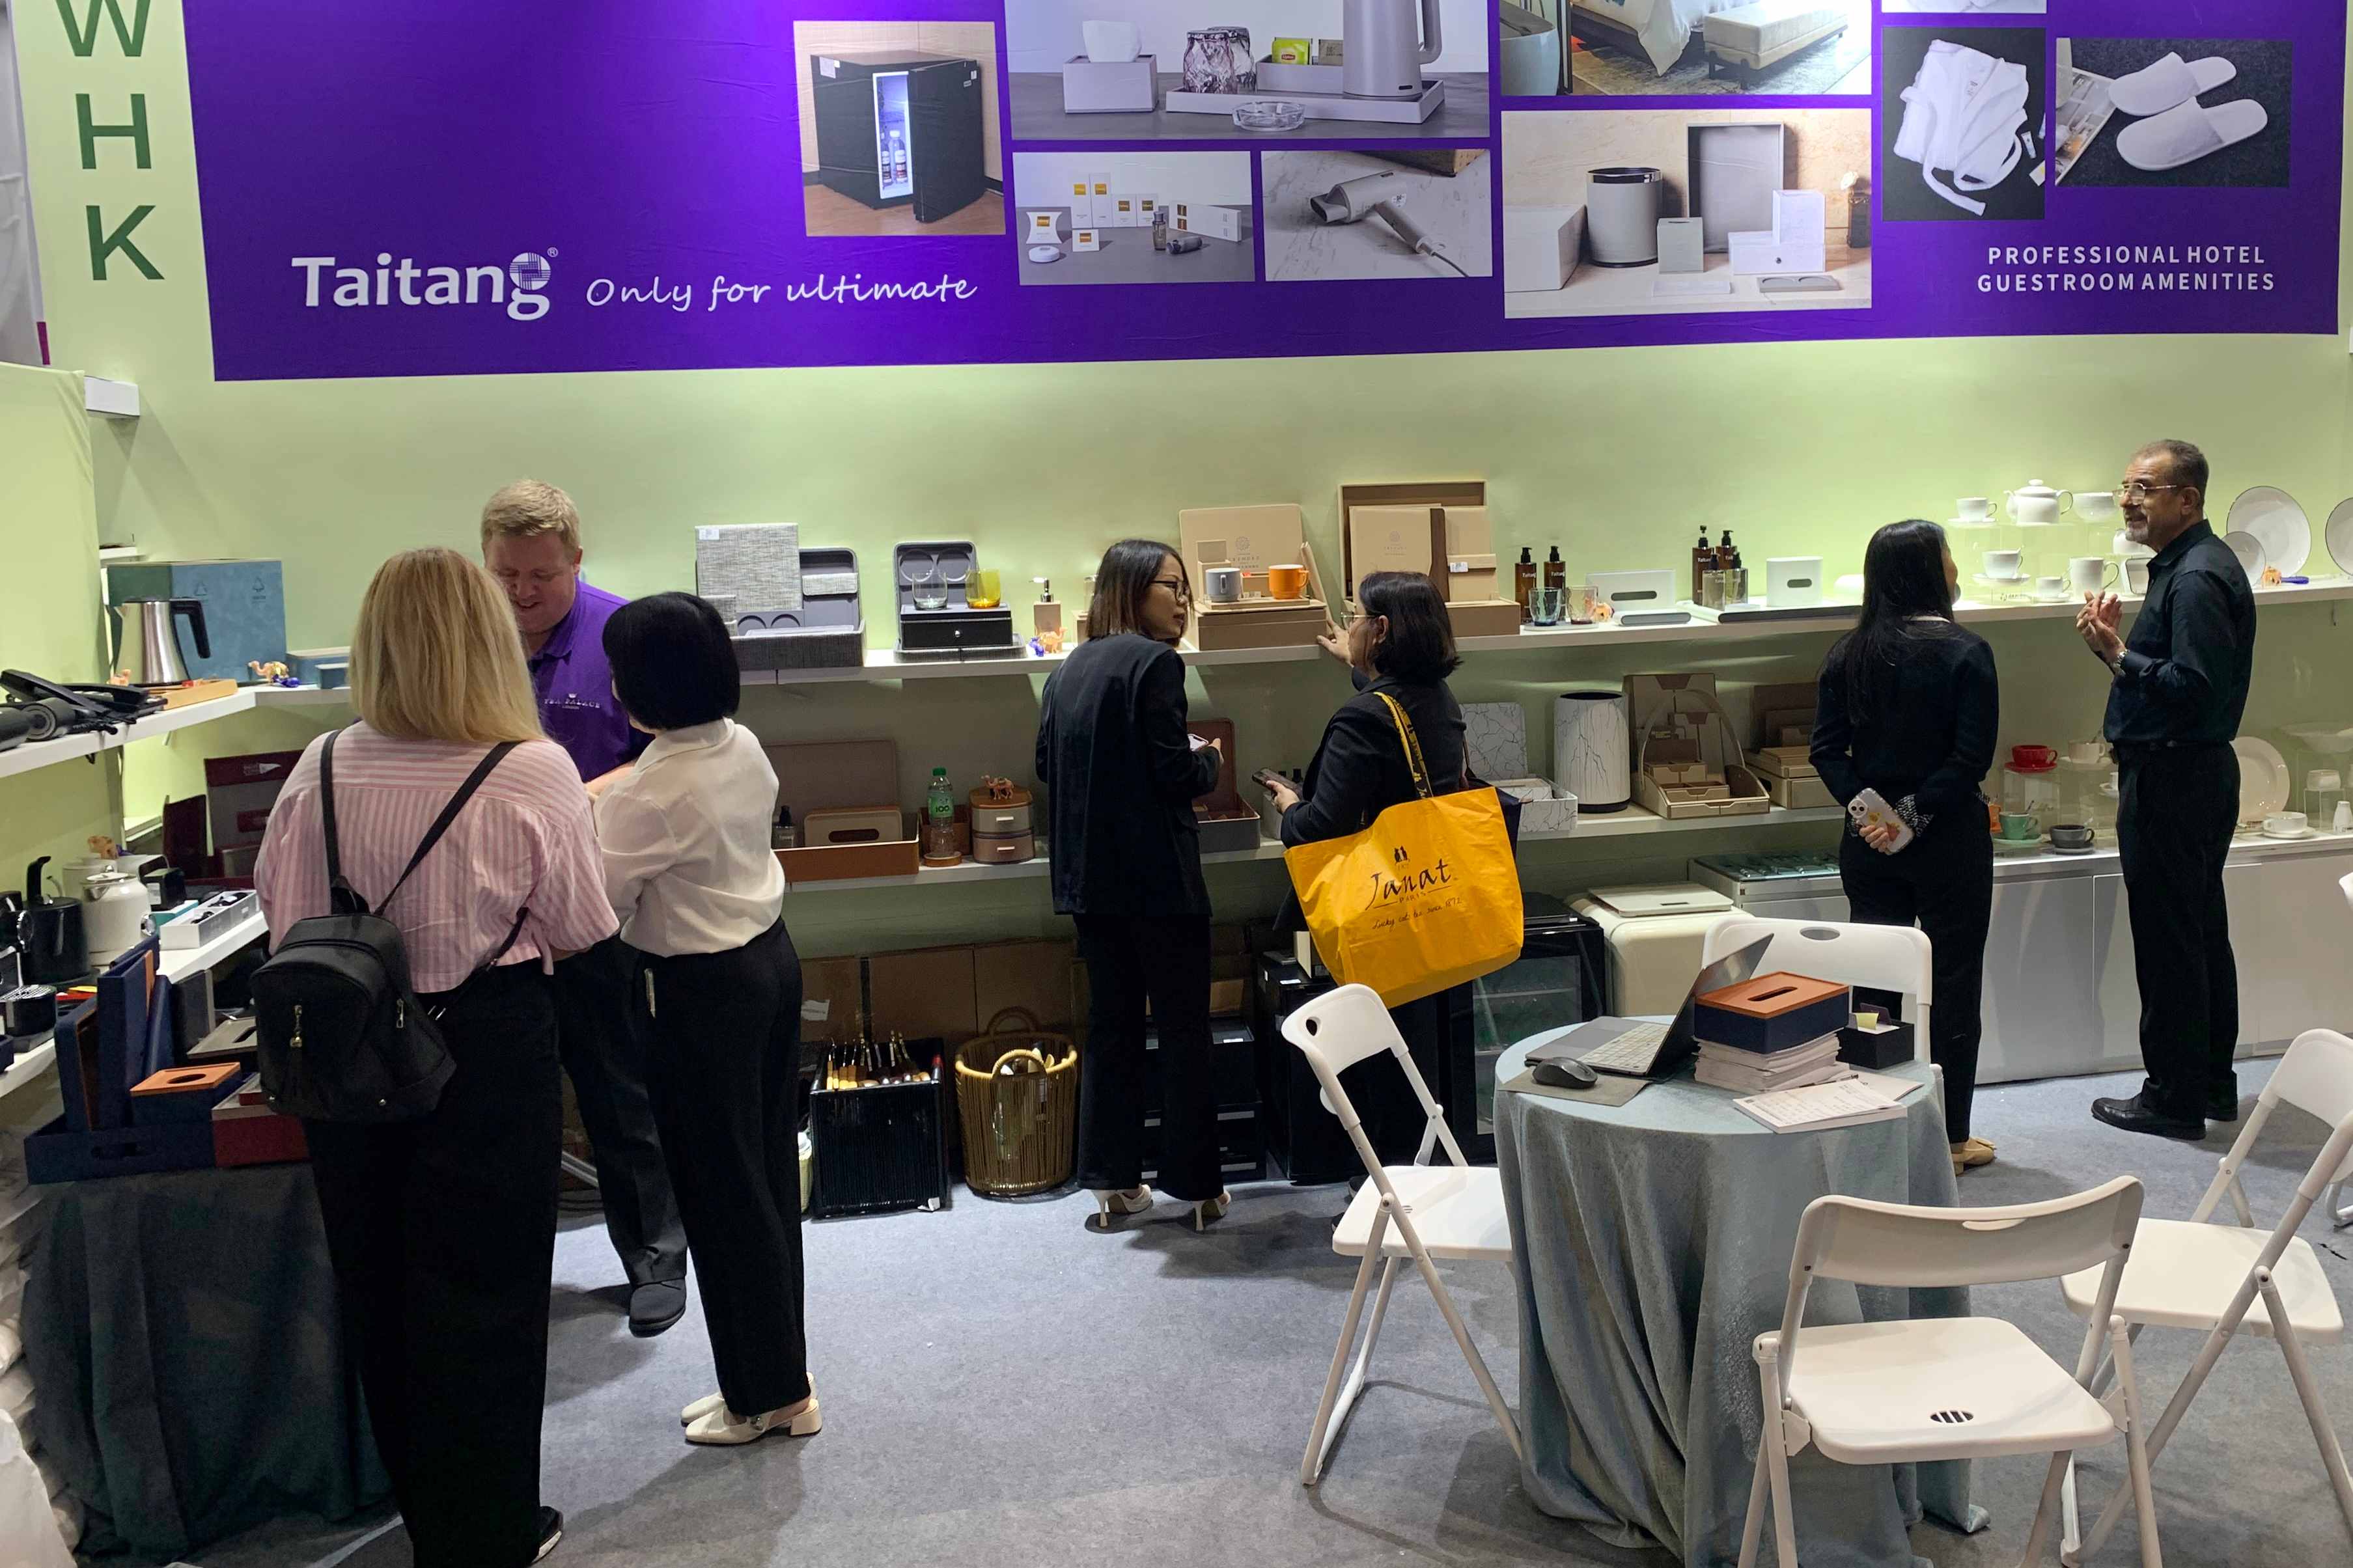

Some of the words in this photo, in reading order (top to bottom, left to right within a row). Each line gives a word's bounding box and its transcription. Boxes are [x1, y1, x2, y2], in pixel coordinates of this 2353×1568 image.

[1988, 245, 2179, 265] PROFESSIONAL
[2187, 245, 2264, 264] HOTEL
[291, 252, 551, 321] Taitang
[586, 276, 691, 312] Only
[708, 276, 771, 311] for
[786, 273, 977, 303] ultimate
[1977, 273, 2134, 292] GUESTROOM
[2141, 272, 2274, 291] AMENITIES
[1365, 858, 1451, 911] Janat
